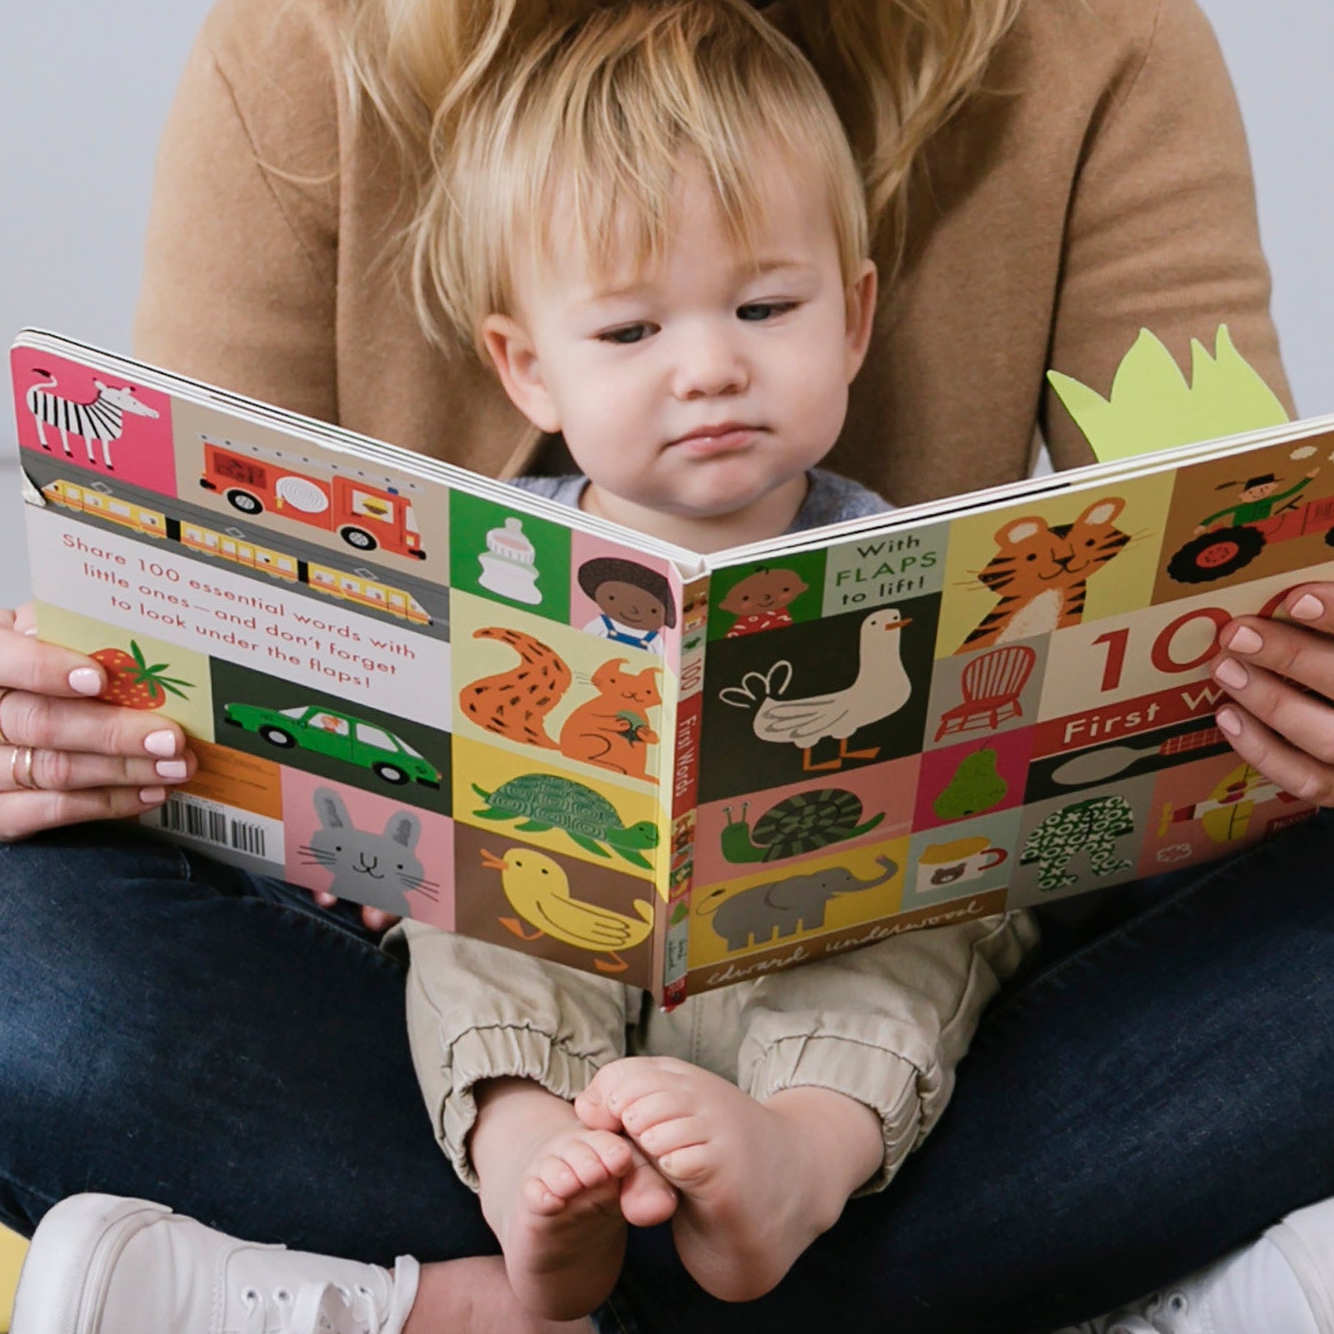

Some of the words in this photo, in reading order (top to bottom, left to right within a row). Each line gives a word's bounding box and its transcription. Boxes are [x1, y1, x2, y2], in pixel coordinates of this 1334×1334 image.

[857, 535, 920, 559] With
[836, 551, 937, 587] FLAPS
[842, 593, 866, 605] to
[879, 575, 924, 597] lift!
[62, 533, 127, 566] Share
[138, 558, 181, 583] 100
[189, 579, 285, 616] essential
[293, 612, 361, 642] words
[369, 637, 416, 660] with
[83, 562, 130, 589] little
[265, 624, 321, 650] don't
[329, 643, 397, 675] forget
[111, 595, 131, 611] to
[140, 603, 187, 629] look
[195, 625, 260, 651] under
[268, 646, 300, 665] the
[309, 657, 370, 689] flaps!
[681, 658, 701, 691] 100
[678, 714, 697, 749] First
[1064, 702, 1161, 744] First
[675, 747, 695, 797] Words
[707, 946, 809, 985] edward
[825, 900, 985, 953] underwood
